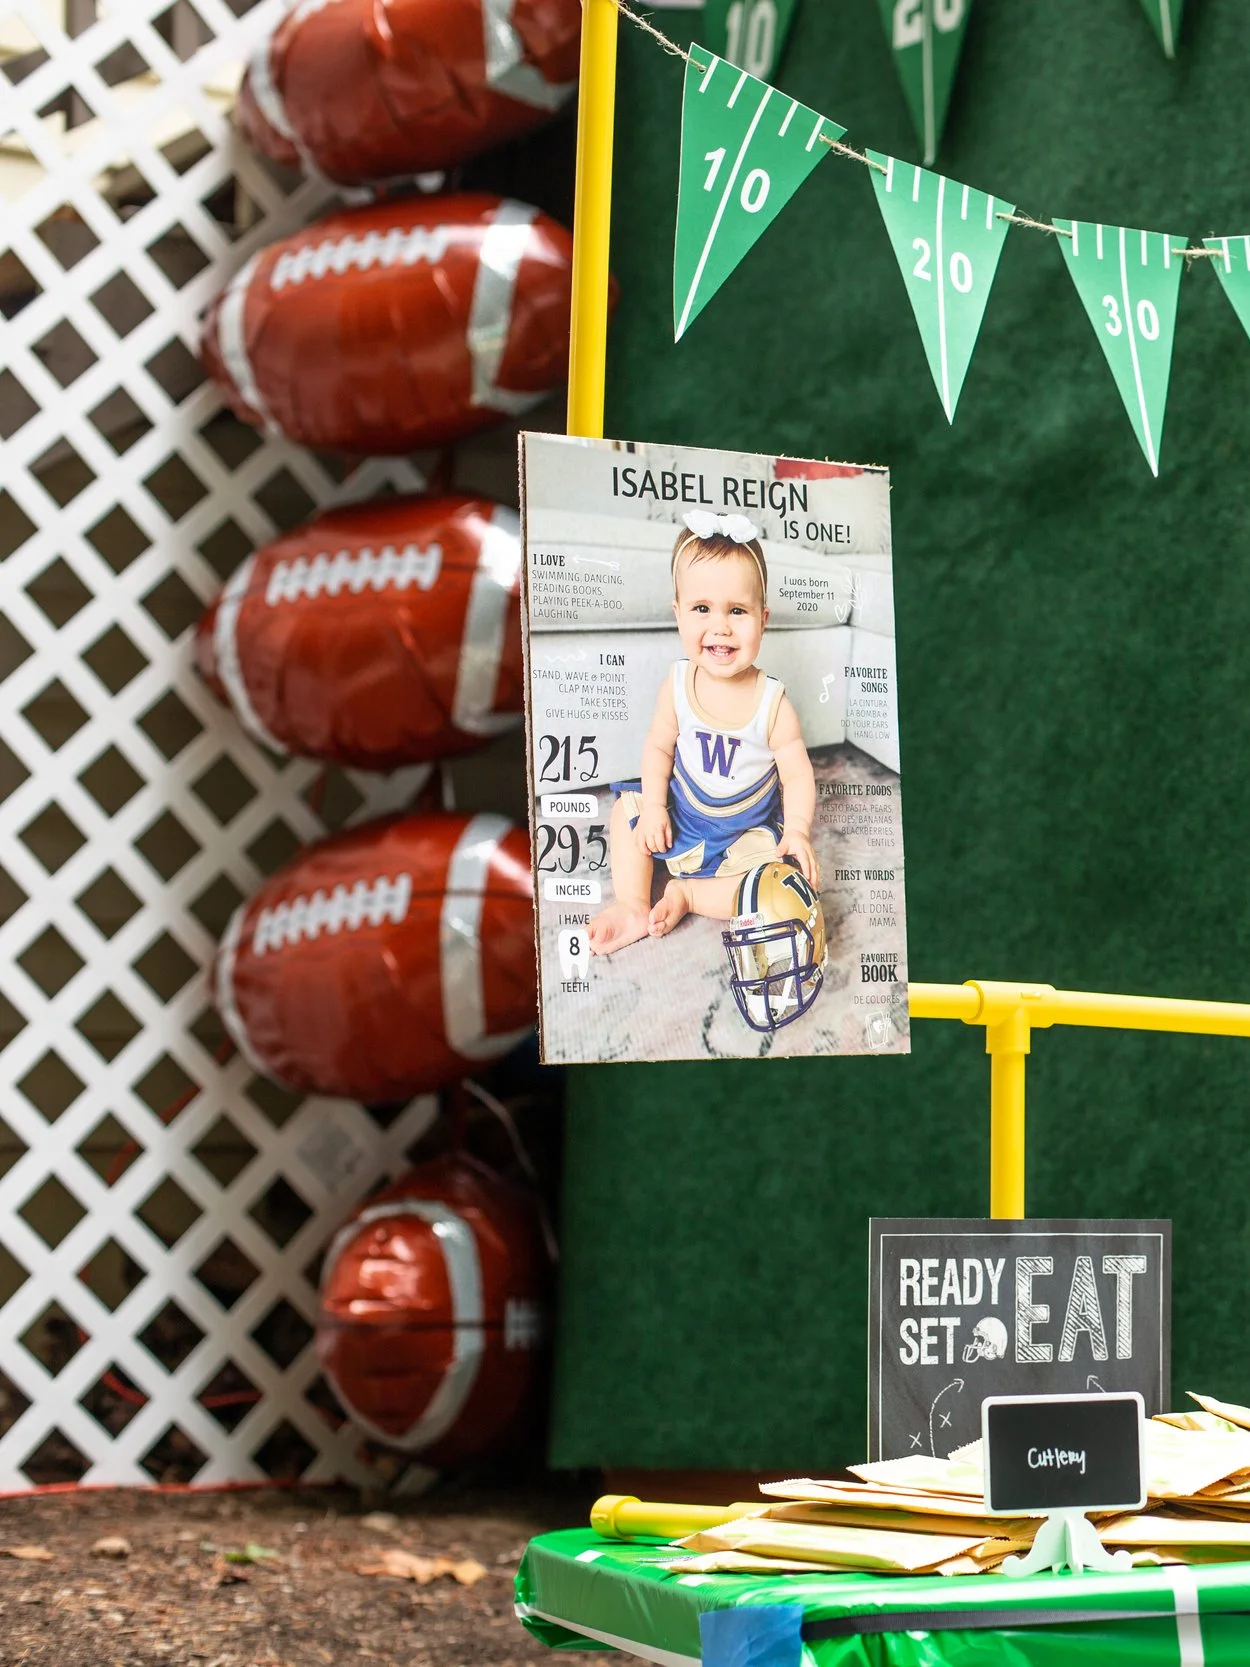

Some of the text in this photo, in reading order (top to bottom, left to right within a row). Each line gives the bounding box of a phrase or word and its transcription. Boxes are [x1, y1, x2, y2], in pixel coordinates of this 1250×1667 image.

[703, 146, 771, 215] 10
[912, 237, 973, 293] 20
[1102, 294, 1160, 342] 30
[612, 467, 808, 519] ISABEL REIGN
[783, 520, 851, 544] IS ONE!
[533, 553, 566, 567] I LOVE
[532, 582, 571, 594] READING
[789, 578, 807, 587] was
[809, 577, 829, 588] born
[779, 587, 835, 600] September 11
[533, 595, 569, 607] PLAYING
[796, 602, 819, 612] 2020
[533, 608, 579, 620] LAUGHING
[599, 653, 625, 667] I CAN
[564, 671, 589, 682] WAVE
[844, 666, 888, 680] FAVORITE
[558, 683, 580, 694] CLAP
[582, 685, 594, 695] MY
[861, 681, 889, 694] SONGS
[580, 697, 600, 708] TAKE
[545, 708, 567, 719] GIVE
[567, 709, 591, 720] HUGS
[601, 710, 629, 721] KISSES
[872, 721, 889, 729] EARS
[539, 735, 599, 782] 21.5
[696, 731, 741, 778] W
[819, 783, 892, 796] FAVORITE FOODS
[550, 801, 591, 813] POUNDS
[822, 803, 844, 812] PESTO
[536, 824, 607, 873] 29.5
[867, 838, 895, 847] LENTILS
[835, 869, 895, 881] FIRST WORDS
[555, 884, 591, 896] INCHES
[852, 903, 867, 914] ALL
[564, 914, 590, 925] HAVE
[869, 917, 897, 927] MAMA
[569, 936, 580, 956] 8
[860, 952, 898, 963] FAVORITE
[861, 964, 899, 983] BOOK
[561, 981, 590, 993] TEETH
[854, 994, 900, 1005] DE COLORES
[899, 1257, 1006, 1307] READY
[1015, 1255, 1147, 1363] EAT
[899, 1317, 960, 1366] SET
[1027, 1447, 1086, 1475] Cutlery
